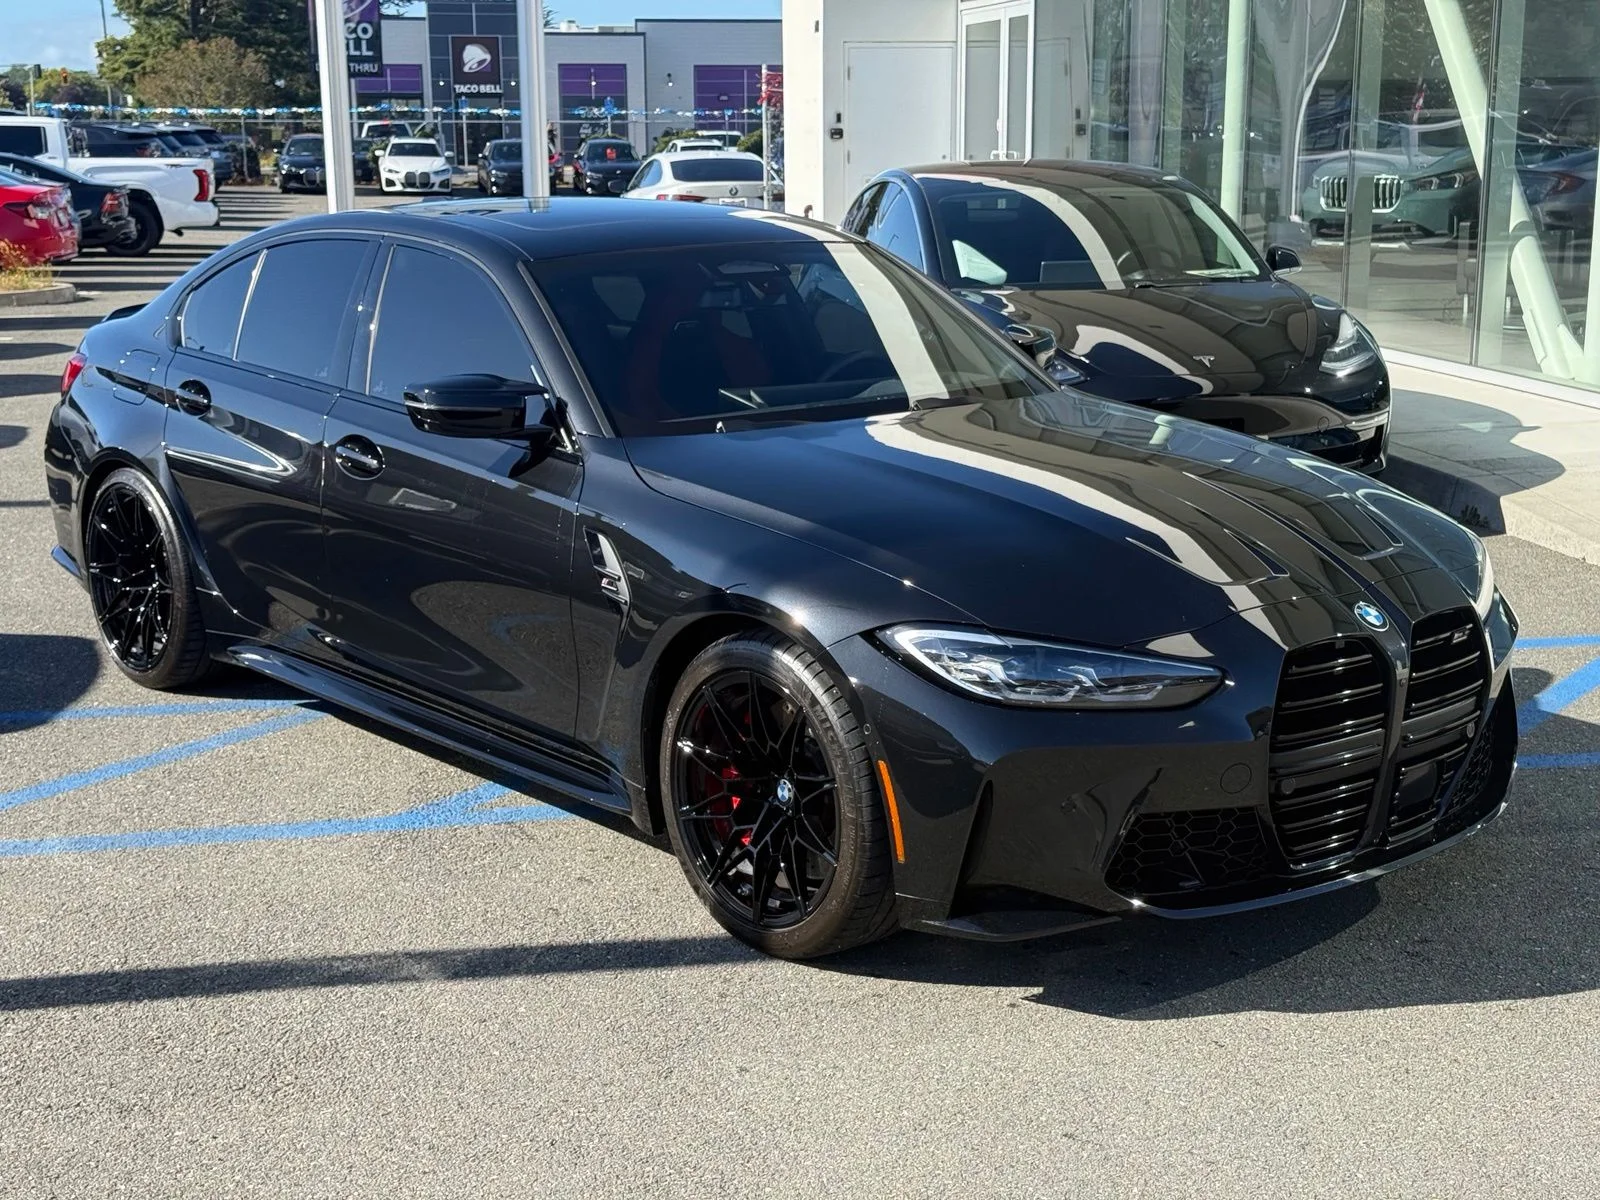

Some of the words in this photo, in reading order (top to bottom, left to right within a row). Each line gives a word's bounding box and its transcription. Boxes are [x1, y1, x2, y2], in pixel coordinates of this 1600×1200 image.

[349, 63, 378, 72] THRU
[454, 84, 478, 94] TACO
[479, 84, 503, 94] BELL
